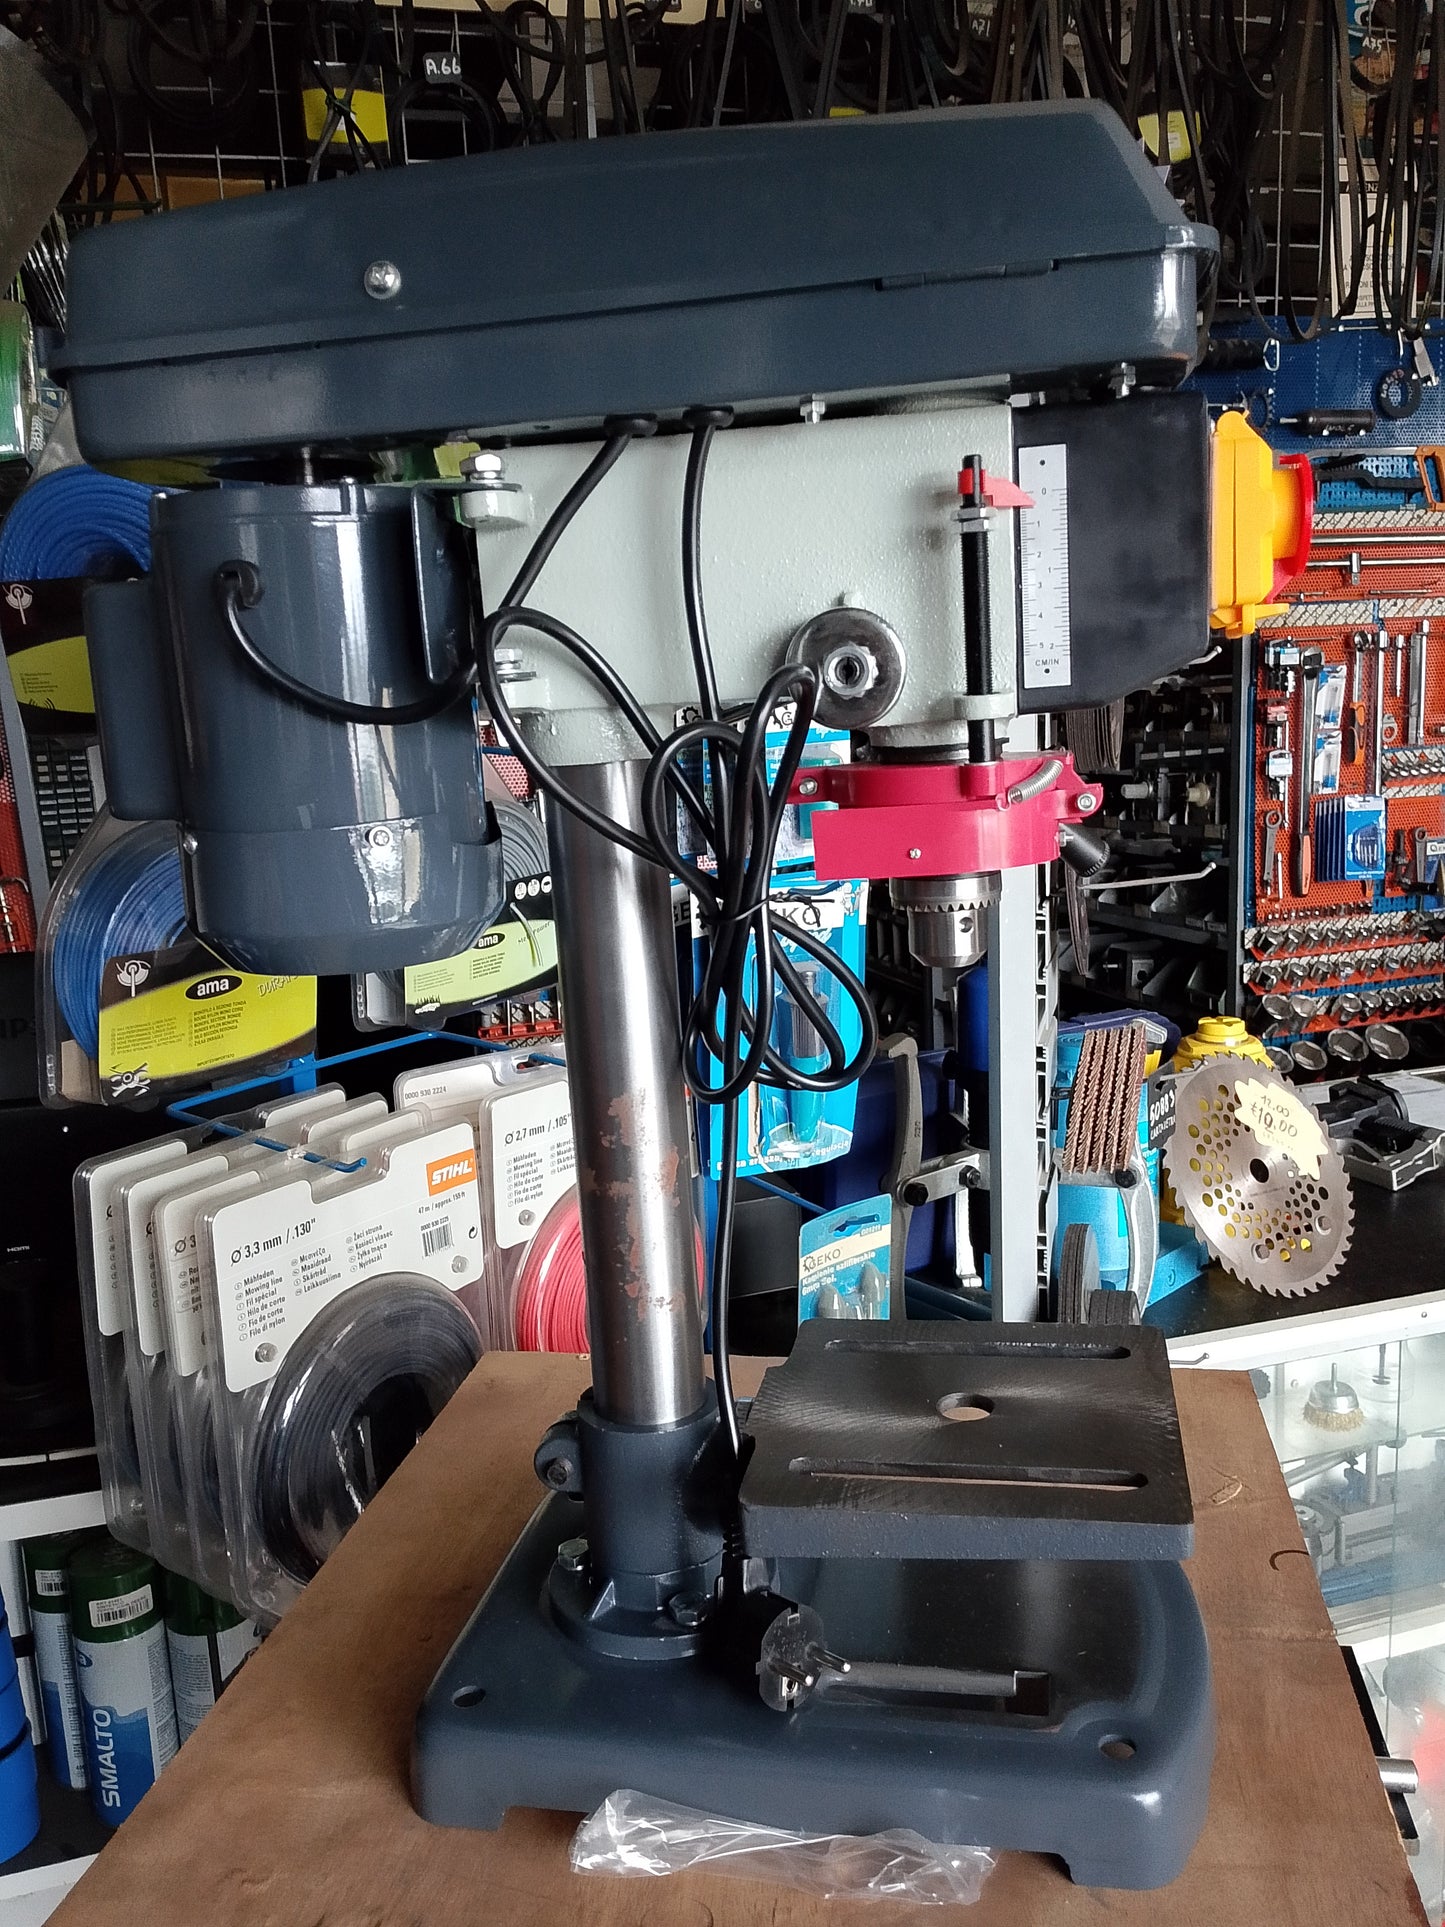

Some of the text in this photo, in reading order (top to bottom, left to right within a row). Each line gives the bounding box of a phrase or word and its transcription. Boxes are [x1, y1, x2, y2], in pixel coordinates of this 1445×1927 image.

[425, 58, 461, 76] A.66
[478, 934, 499, 947] ama
[197, 978, 229, 997] ama
[529, 1125, 545, 1136] mm
[431, 1159, 473, 1186] STIHL
[375, 1230, 393, 1242] vlasec
[245, 1241, 260, 1260] 3,3
[263, 1235, 282, 1251] mm
[301, 1254, 332, 1273] Maaidraad
[245, 1276, 283, 1297] Mowing line
[304, 1272, 342, 1293] Leikkuusiima
[255, 1288, 277, 1303] spécial
[247, 1296, 286, 1317] Hilo de corte
[248, 1307, 283, 1328] Fio de corte
[249, 1317, 285, 1338] Filo di nylon
[93, 1709, 121, 1808] SMALTO
